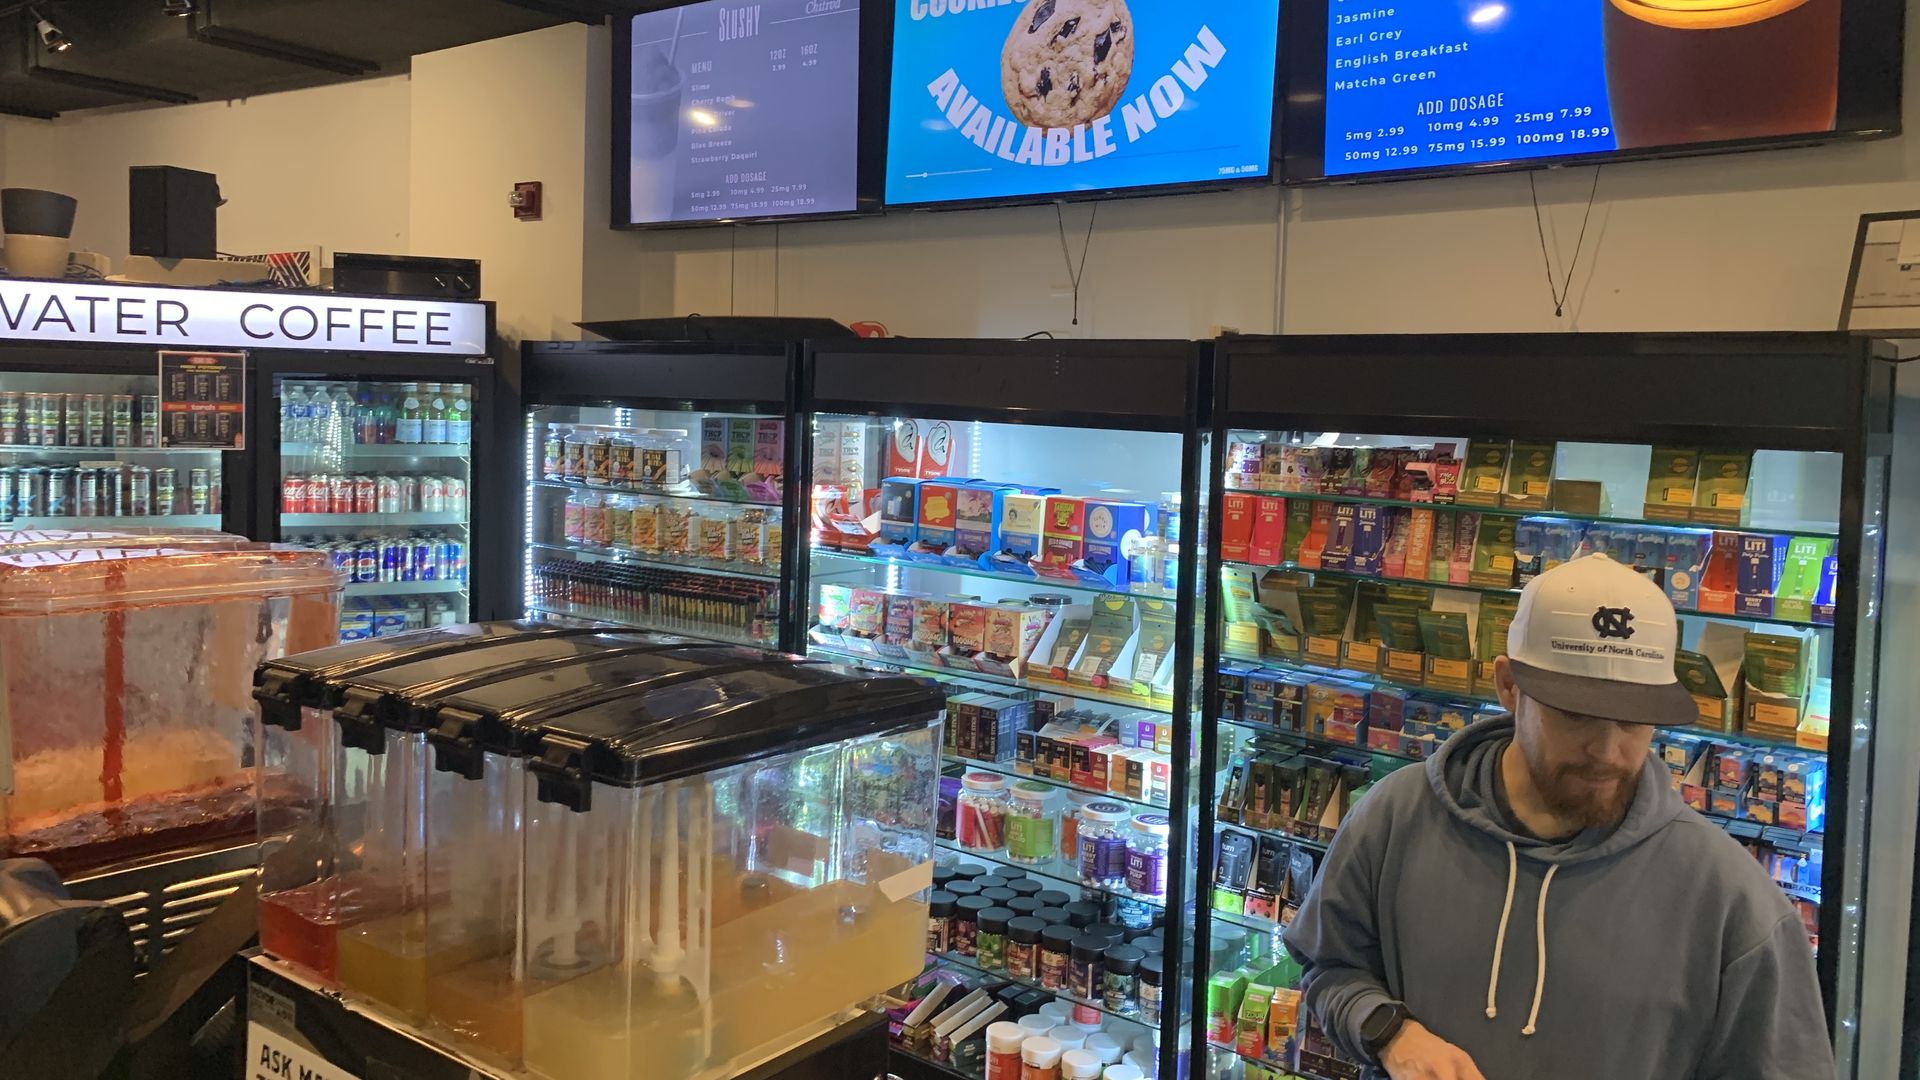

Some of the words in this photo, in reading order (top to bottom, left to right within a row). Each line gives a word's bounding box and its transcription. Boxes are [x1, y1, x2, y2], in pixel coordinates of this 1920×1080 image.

[719, 5, 760, 41] SLUSHY
[1336, 8, 1395, 25] Jasmine
[1336, 34, 1364, 47] Earl
[1369, 29, 1403, 42] Grey
[1335, 52, 1389, 69] English
[1395, 41, 1469, 61] Breakfast
[691, 60, 713, 74] MENU
[1335, 77, 1387, 92] Matcha
[1392, 69, 1437, 84] Green
[927, 68, 1117, 166] AVAILABLE
[1121, 25, 1227, 143] NOW
[1417, 101, 1444, 116] ADD
[1450, 93, 1505, 112] DOSAGE
[1515, 111, 1554, 124] 25mg
[1560, 106, 1592, 118] 7.99
[1345, 131, 1373, 142] 5mg
[1378, 126, 1405, 138] 2.99
[1428, 121, 1463, 134] 10mg
[1469, 116, 1499, 128] 4.99
[1428, 141, 1465, 154] 75mg
[1470, 136, 1506, 149] 15.99
[1516, 131, 1565, 146] 100mg
[1570, 126, 1610, 139] 18.99
[691, 154, 729, 164] Strawberry
[1345, 149, 1380, 161] 50mg
[1385, 145, 1418, 157] 12.99
[725, 174, 739, 184] ADD
[741, 171, 767, 183] DOSAGE
[772, 199, 795, 207] 100mg
[239, 303, 453, 347] COFFEE
[1744, 541, 1766, 552] LIT!
[1552, 641, 1595, 654] University
[1608, 645, 1634, 656] North
[1636, 648, 1665, 660] Carolina
[260, 1044, 293, 1080] ASK
